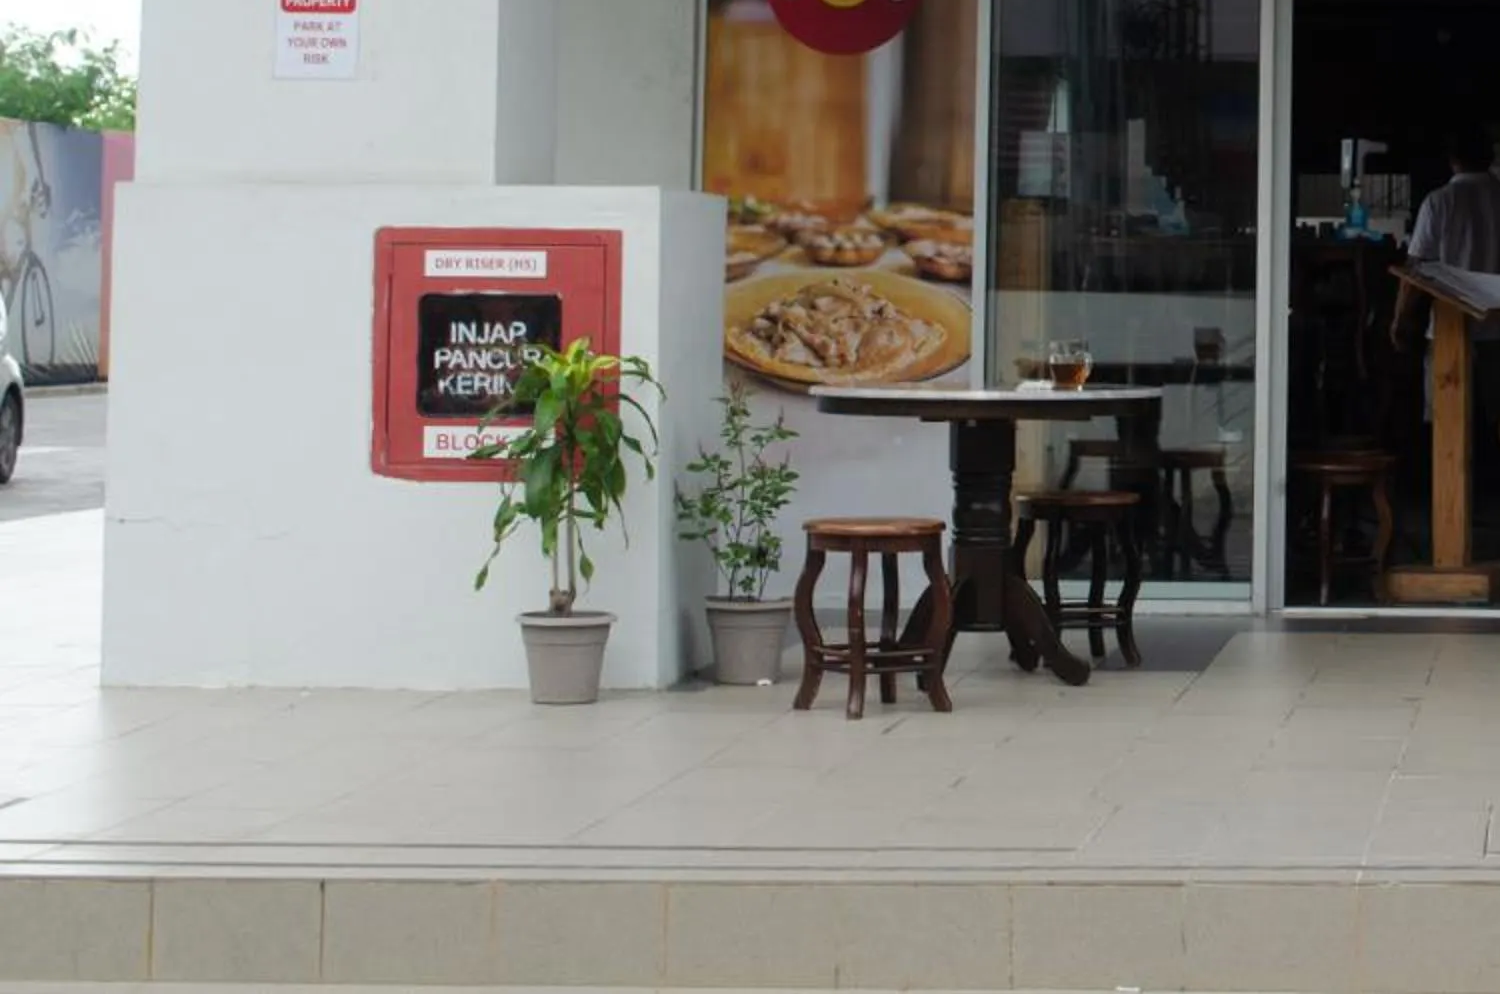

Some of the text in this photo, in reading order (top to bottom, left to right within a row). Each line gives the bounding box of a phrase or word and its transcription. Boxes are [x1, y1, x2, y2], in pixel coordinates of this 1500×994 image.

[435, 257, 461, 270] DRY
[465, 257, 505, 271] RISER
[450, 320, 527, 344] INJAP
